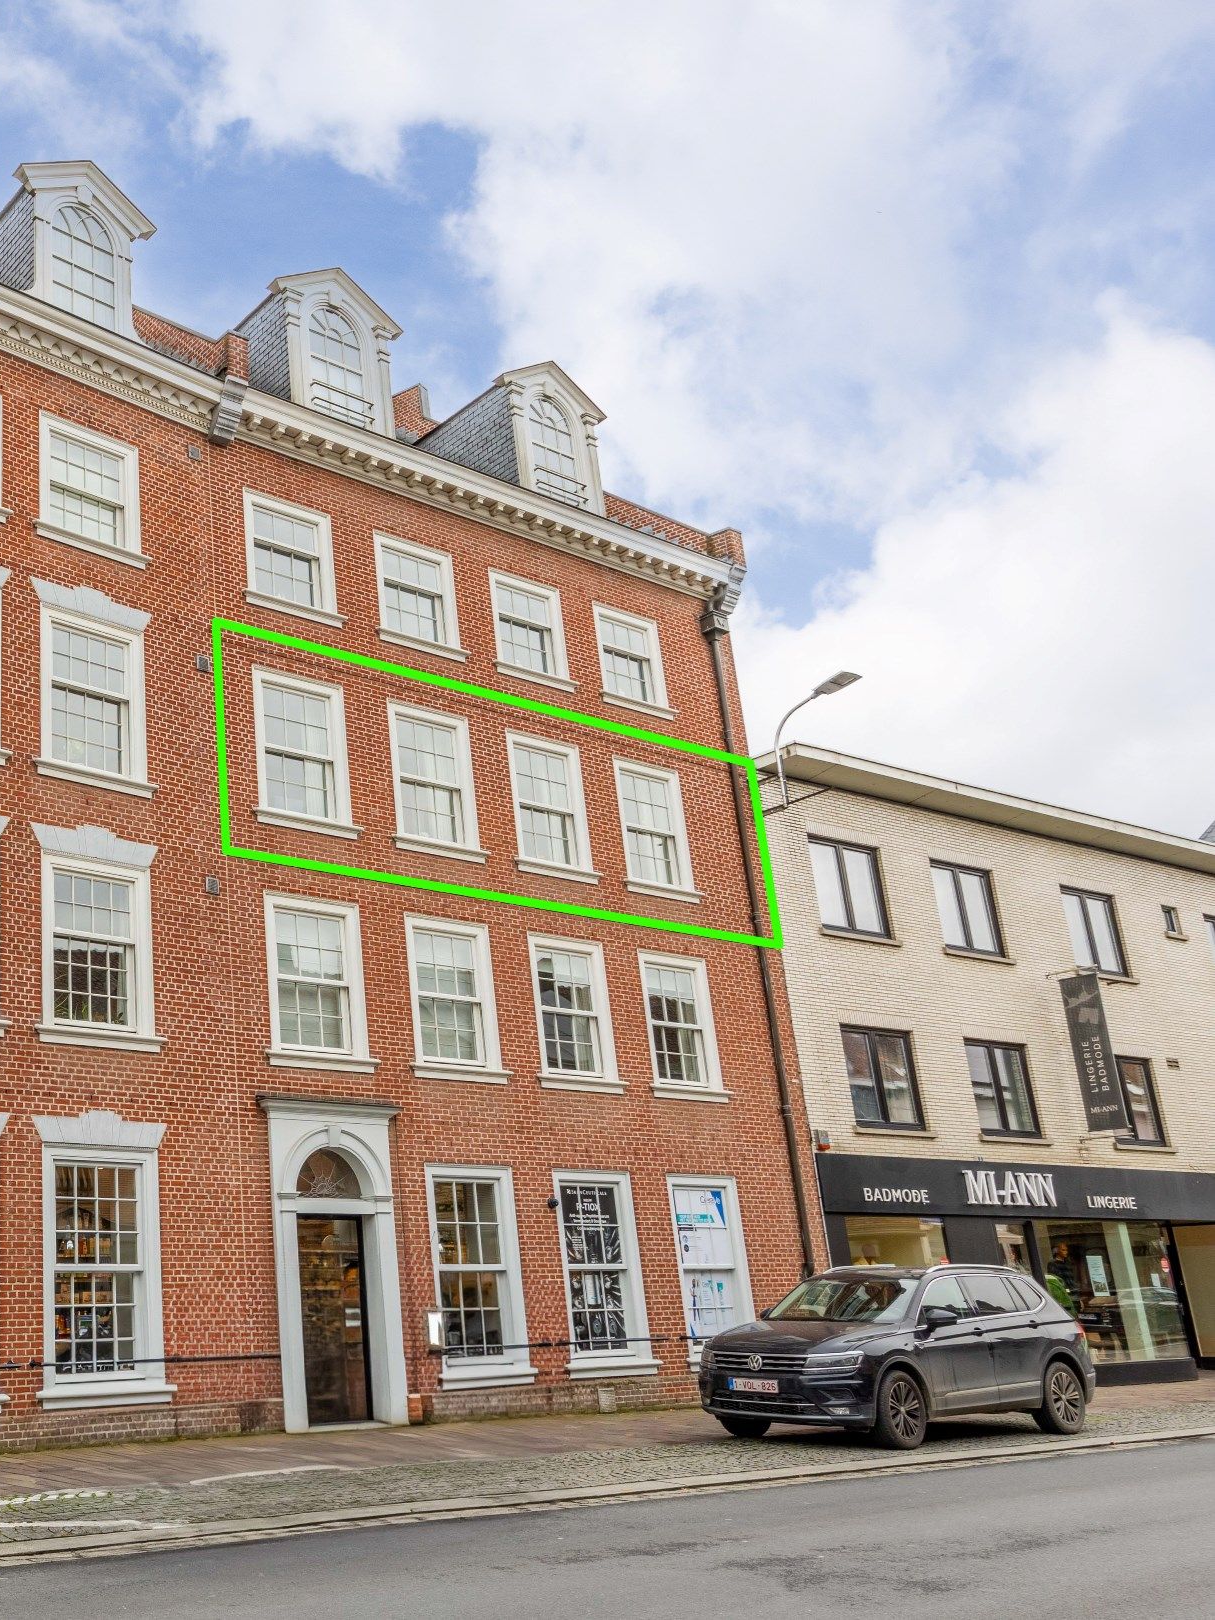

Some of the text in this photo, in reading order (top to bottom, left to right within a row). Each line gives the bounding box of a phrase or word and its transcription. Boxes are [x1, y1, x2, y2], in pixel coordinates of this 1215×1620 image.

[1082, 1041, 1099, 1093] LINGERIE
[1091, 1036, 1110, 1092] BADMODE
[1090, 1104, 1118, 1114] MI-ANN
[863, 1187, 930, 1204] BADMODE
[961, 1169, 1058, 1207] MI-ANN
[1086, 1195, 1138, 1210] LINGERIE
